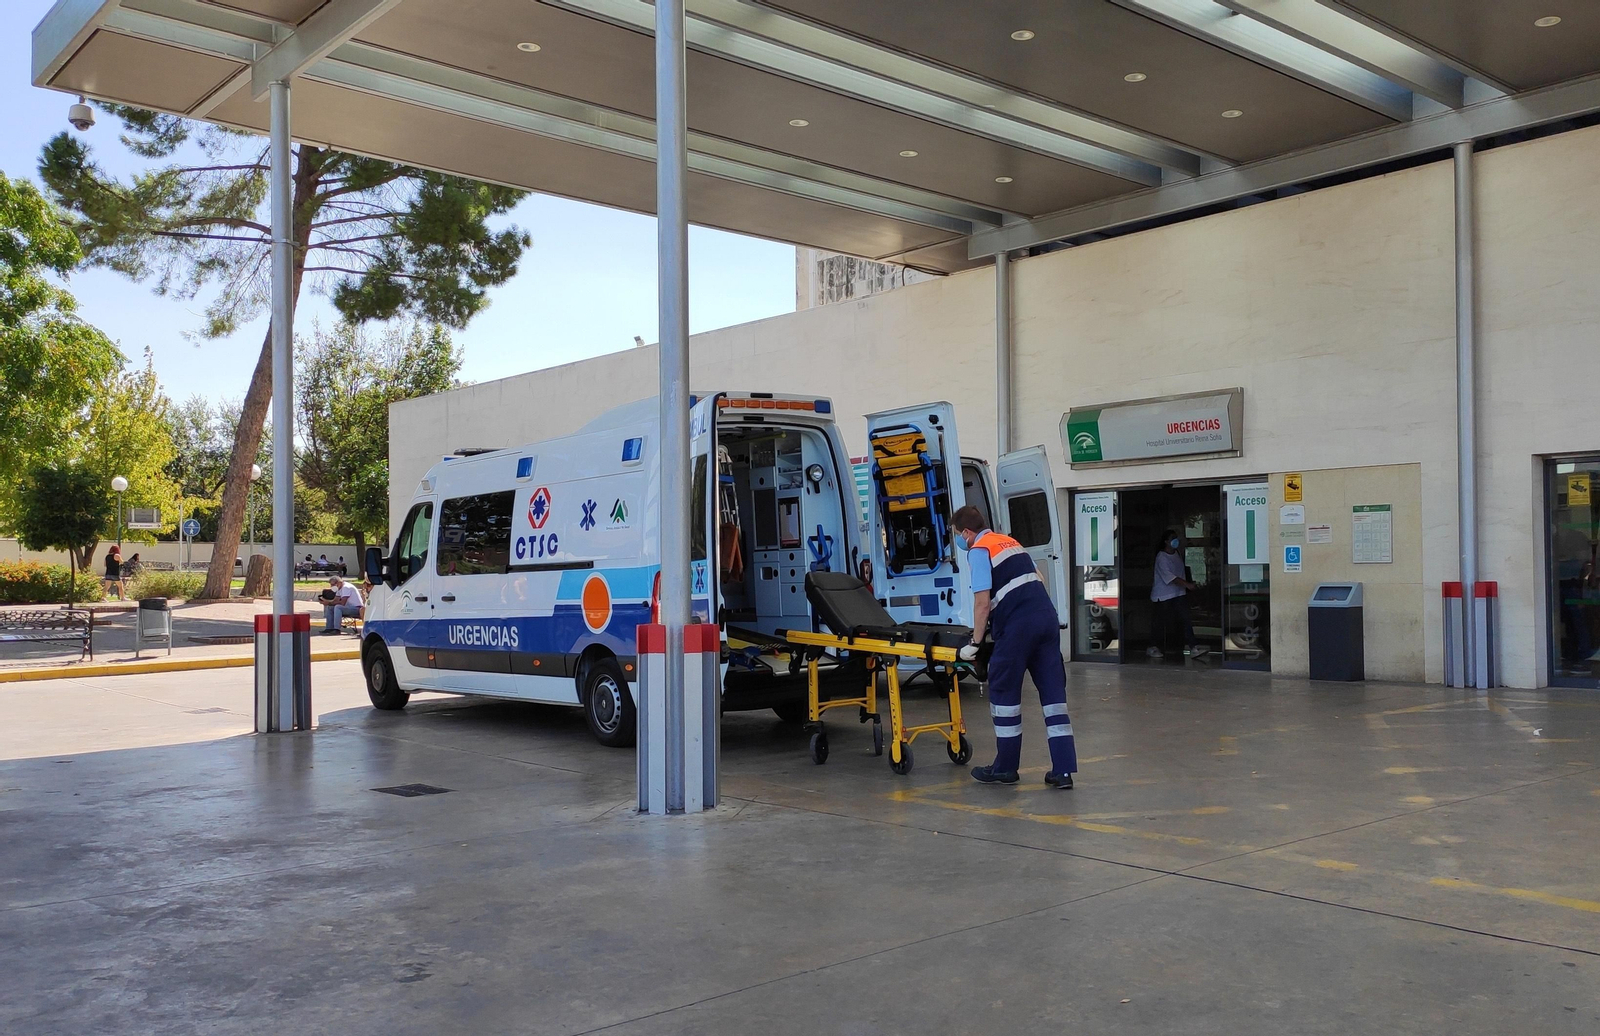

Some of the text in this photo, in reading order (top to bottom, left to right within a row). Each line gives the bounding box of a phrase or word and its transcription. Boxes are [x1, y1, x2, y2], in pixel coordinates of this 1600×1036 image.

[1167, 419, 1220, 434] URGENCIAS
[1146, 439, 1165, 447] Hospital
[1166, 436, 1194, 446] Universitario
[1235, 496, 1266, 506] Acceso
[1081, 504, 1107, 514] Acceso
[516, 533, 558, 559] CTSC
[448, 624, 519, 648] URGENCIAS
